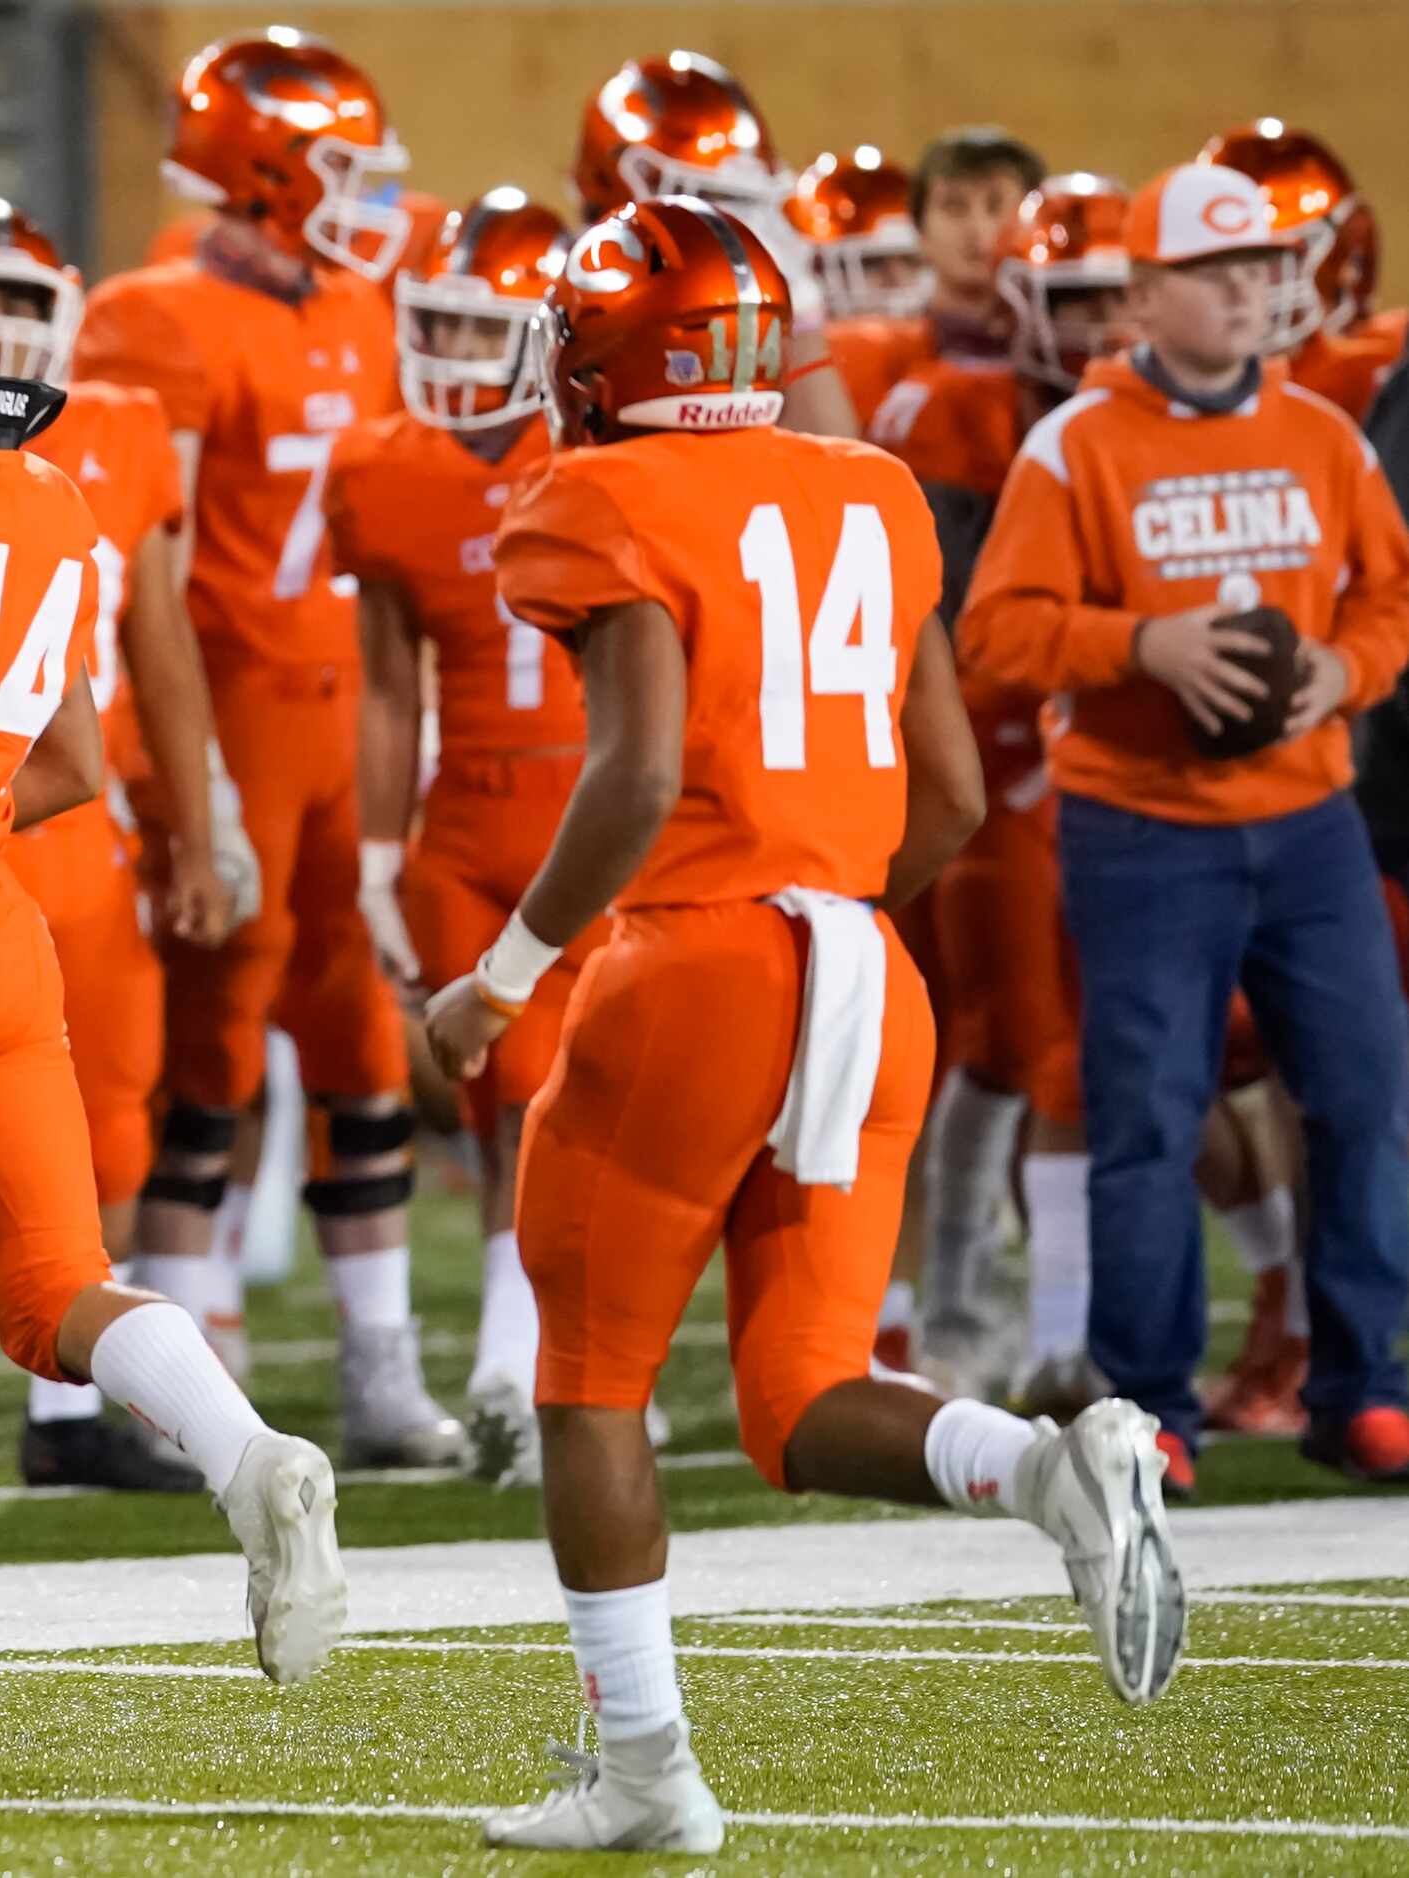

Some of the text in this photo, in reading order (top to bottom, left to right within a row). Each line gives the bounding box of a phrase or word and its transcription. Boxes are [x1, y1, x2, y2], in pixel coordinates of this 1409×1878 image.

[1202, 195, 1252, 234] C
[565, 219, 645, 293] C
[266, 432, 337, 600] 7
[1132, 487, 1322, 560] CELINA
[739, 503, 898, 770] 14
